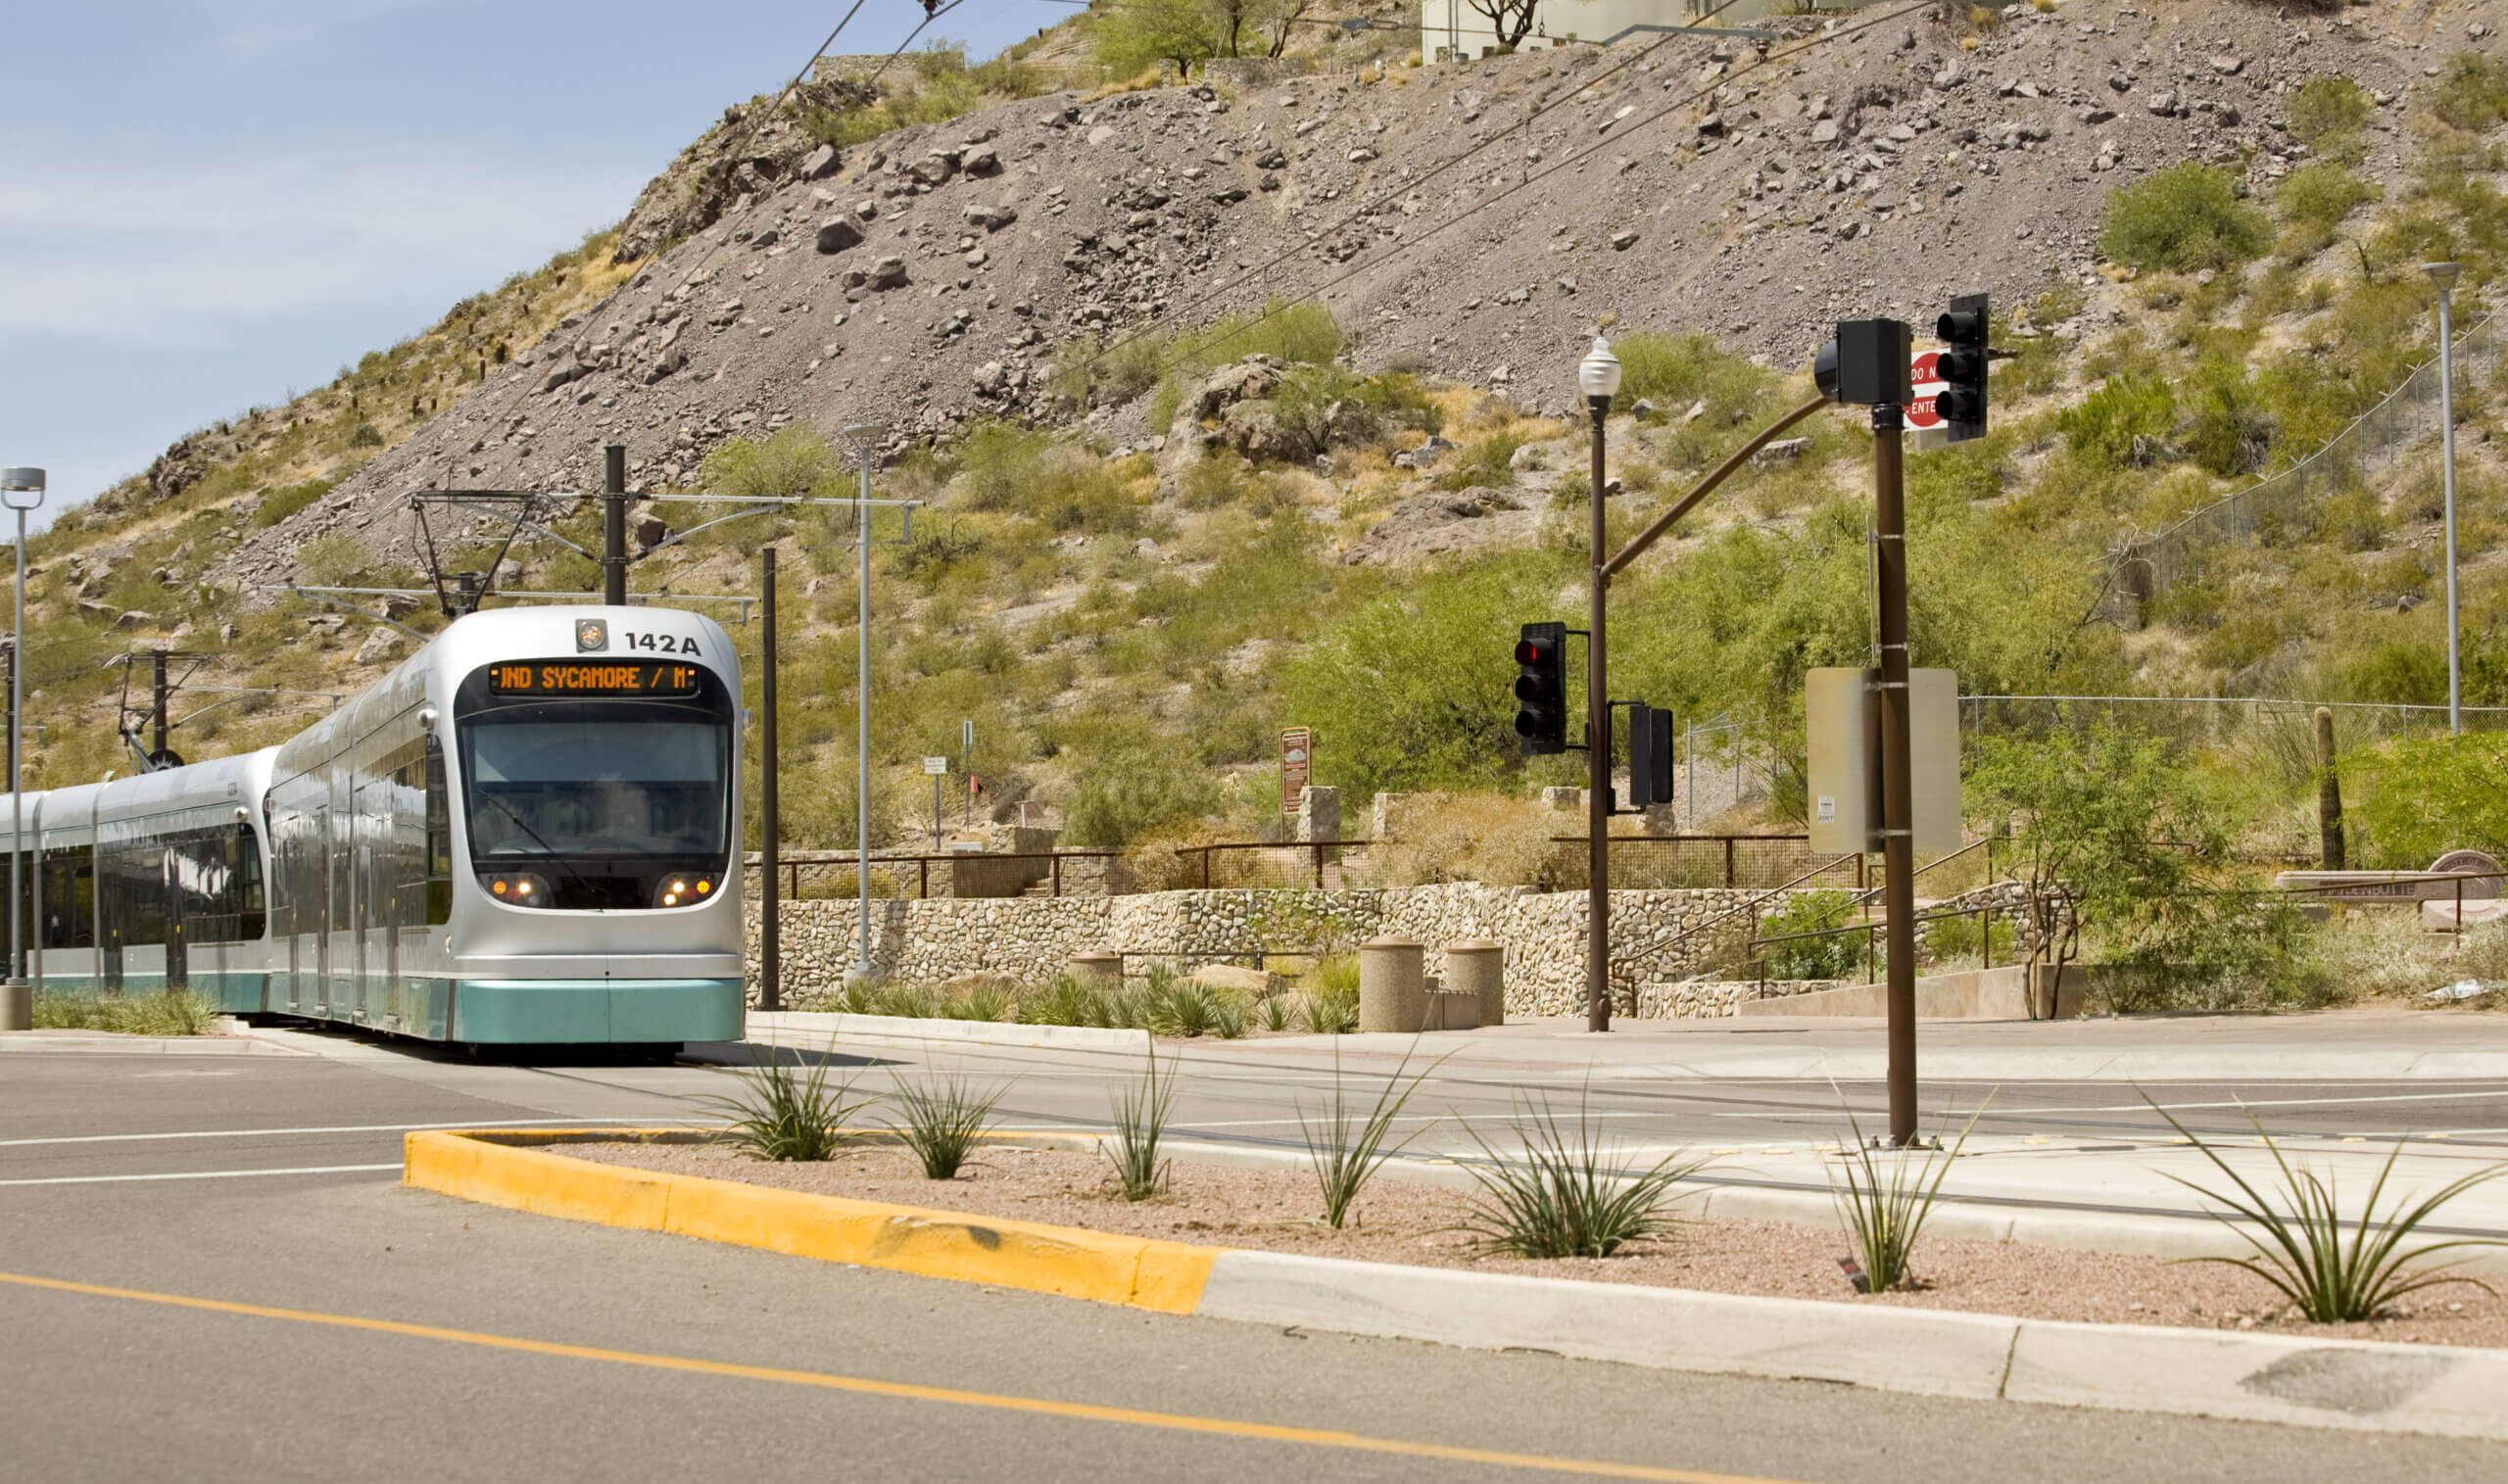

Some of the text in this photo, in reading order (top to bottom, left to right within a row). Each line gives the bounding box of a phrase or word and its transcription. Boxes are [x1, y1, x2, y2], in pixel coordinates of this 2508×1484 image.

[1911, 367, 1923, 381] DO
[1911, 401, 1936, 415] ENTE
[624, 632, 702, 657] 142A
[541, 666, 641, 689] SYCAMORE
[651, 666, 663, 689] /
